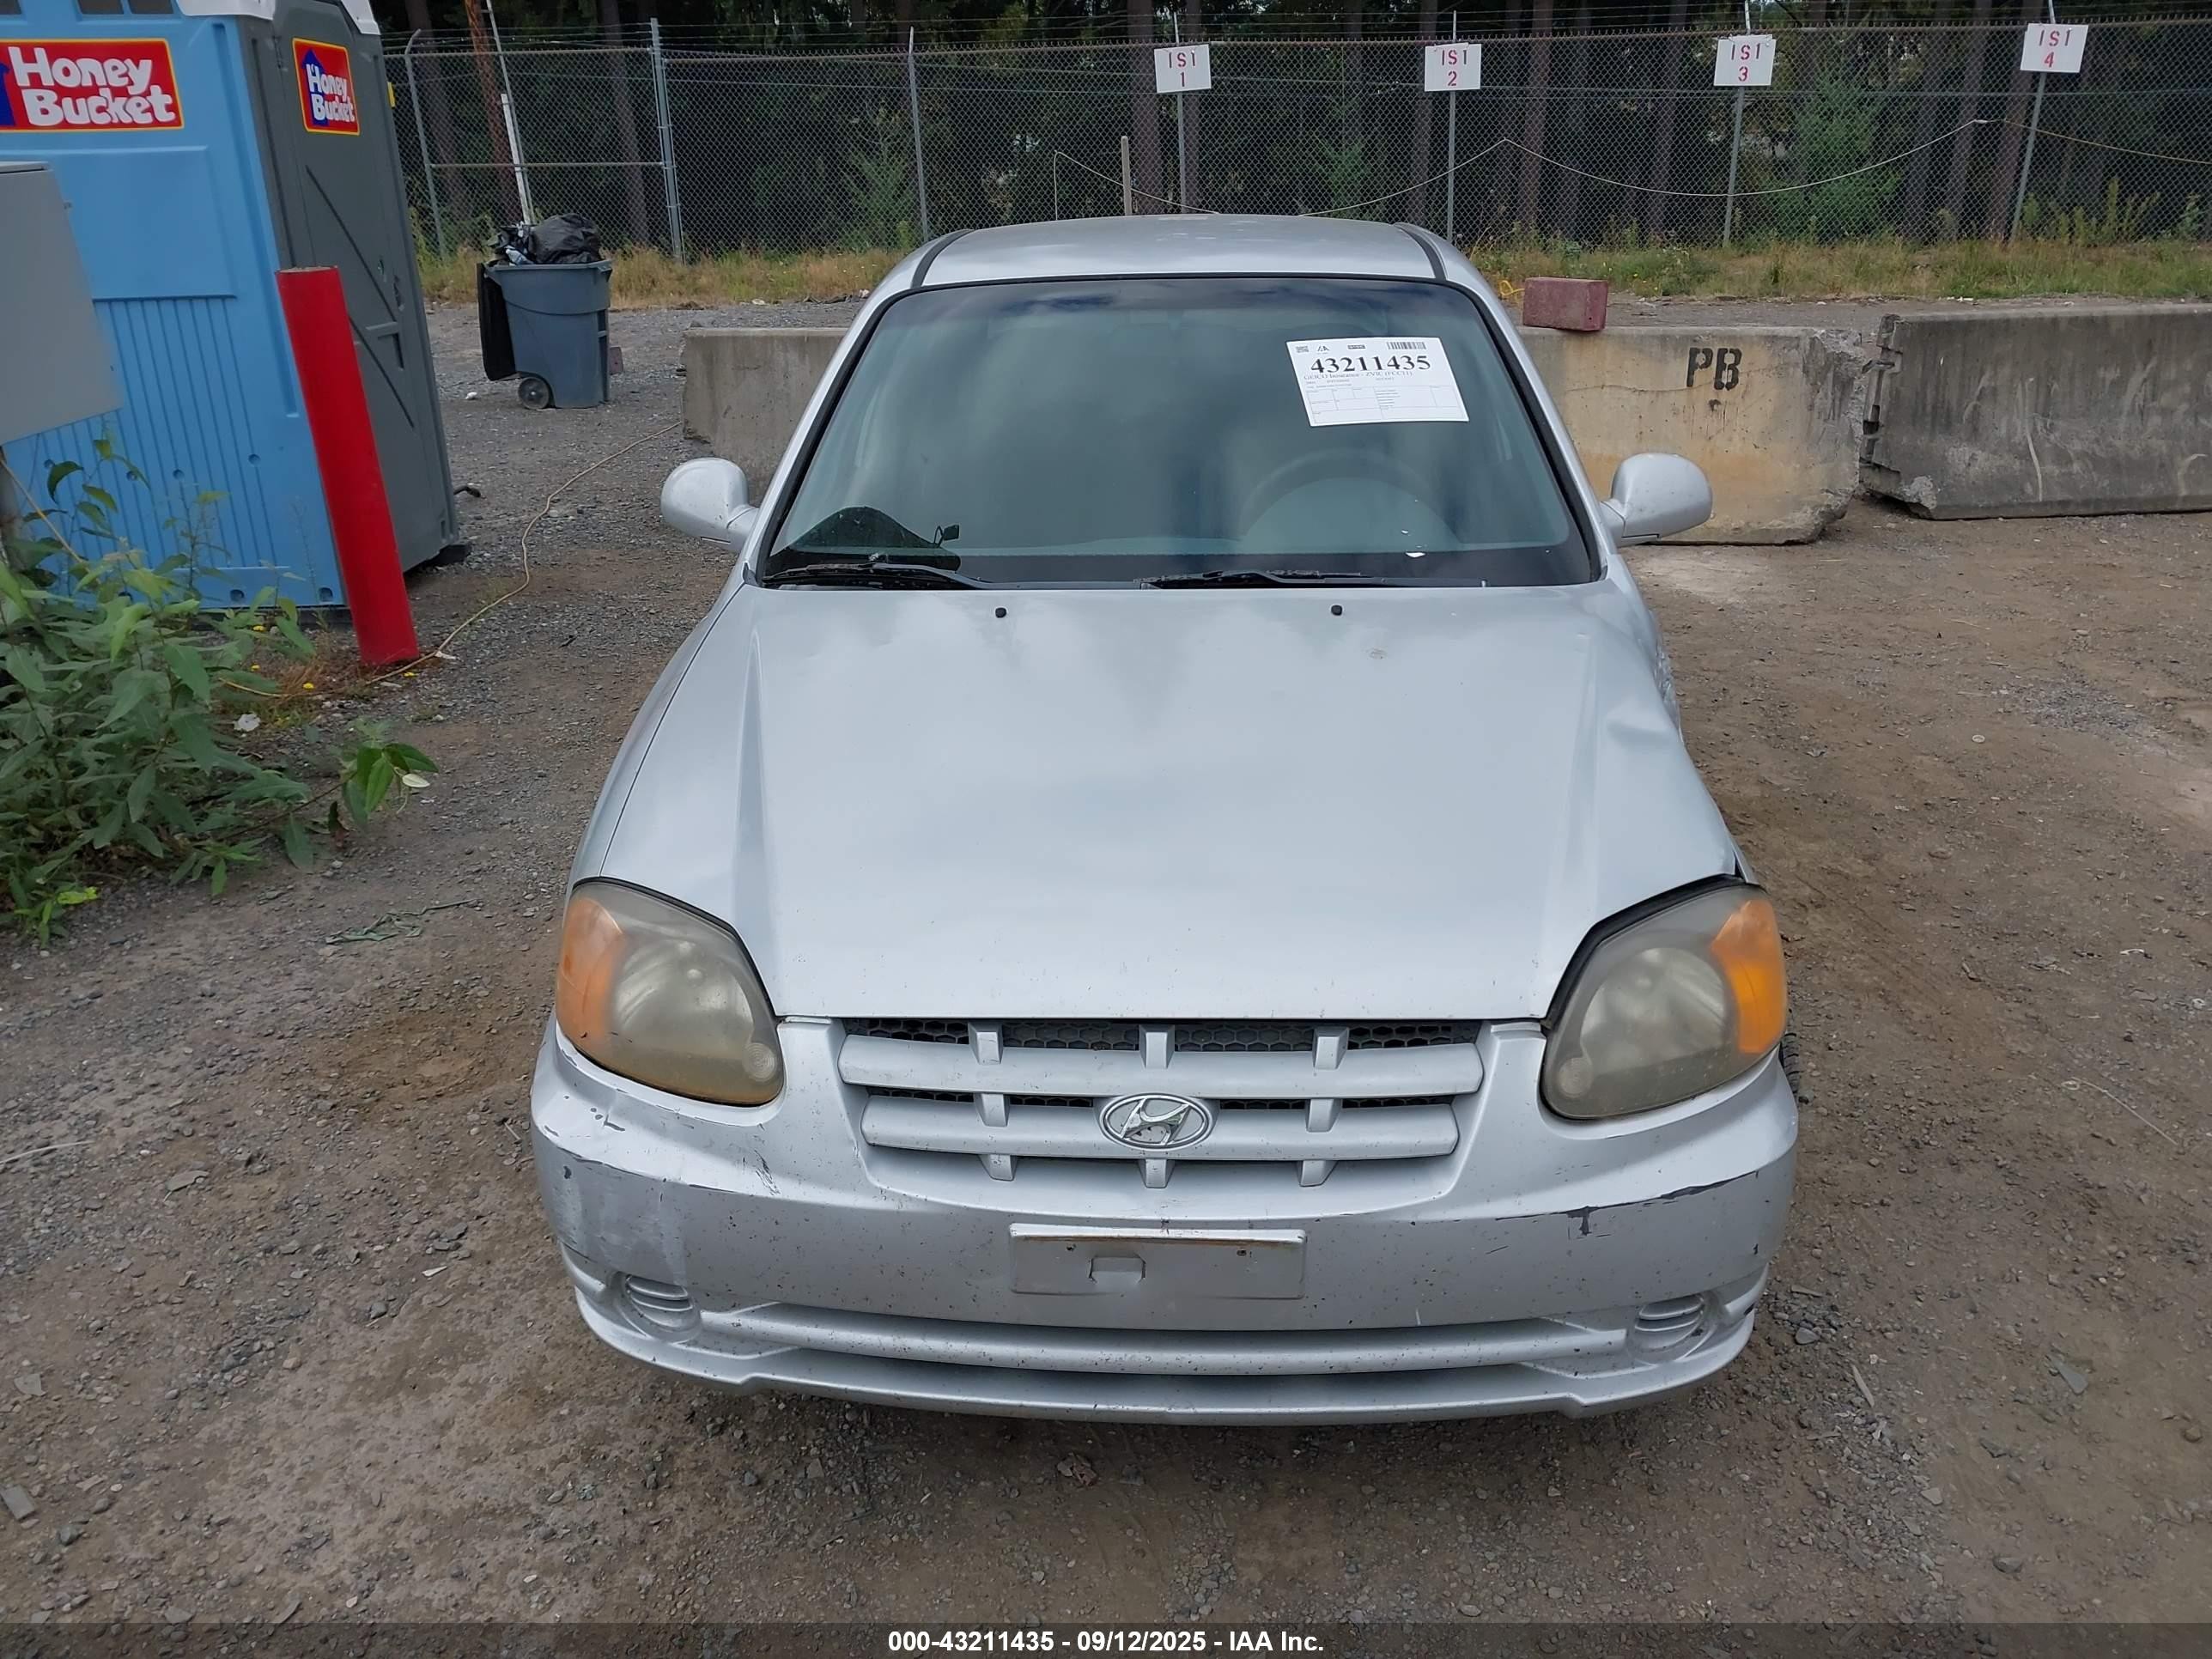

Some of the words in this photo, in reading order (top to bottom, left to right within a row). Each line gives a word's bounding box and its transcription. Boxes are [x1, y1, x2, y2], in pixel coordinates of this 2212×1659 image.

[8, 46, 152, 94] Honey
[1738, 66, 1748, 82] 3
[2044, 52, 2054, 68] 4
[306, 64, 347, 102] Honey
[1448, 70, 1457, 86] 2
[21, 85, 175, 126] Bucket
[310, 94, 355, 122] Bucket
[1310, 355, 1431, 374] 43211435
[1686, 347, 1742, 391] PB
